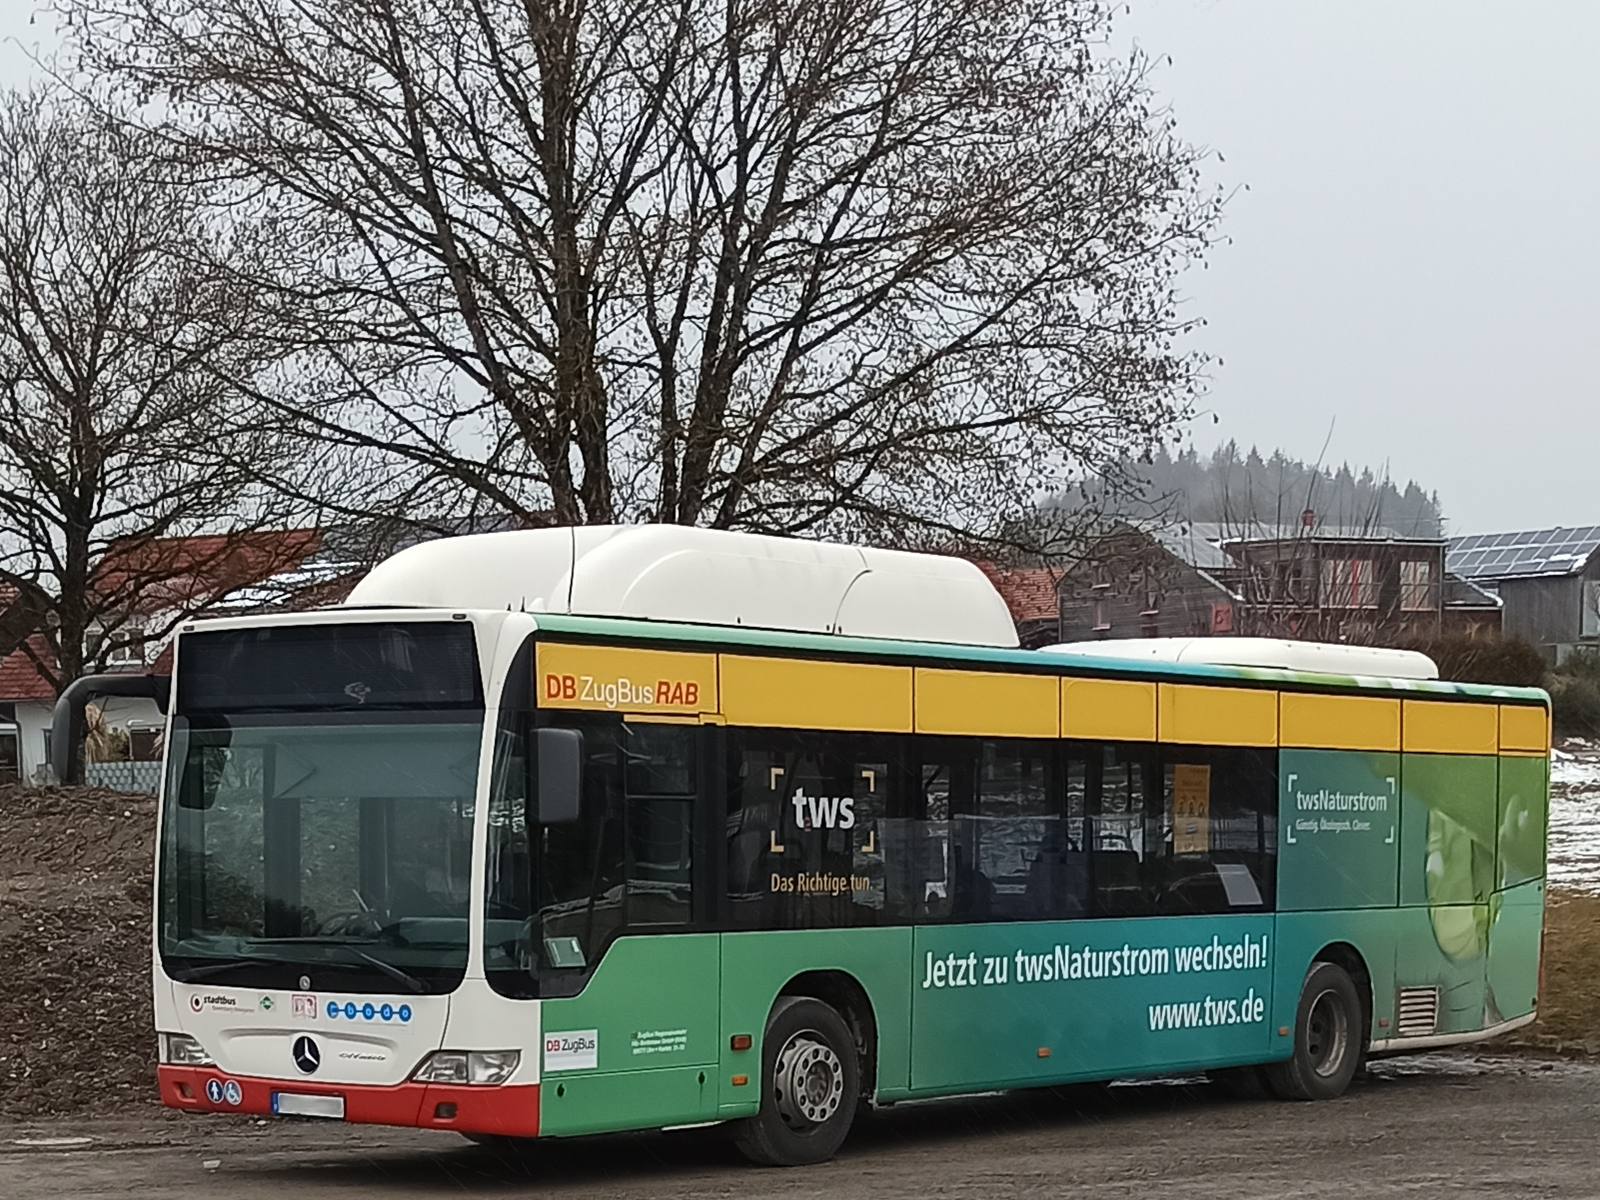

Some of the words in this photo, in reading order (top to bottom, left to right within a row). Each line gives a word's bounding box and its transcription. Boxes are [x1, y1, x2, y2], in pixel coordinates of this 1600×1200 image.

[546, 674, 576, 699] DB
[580, 676, 653, 708] ZugBus
[656, 681, 699, 705] RAB
[792, 787, 855, 829] tws
[1296, 789, 1387, 811] twsNaturstrom
[771, 873, 794, 892] Das
[797, 871, 847, 896] Richtige
[922, 952, 977, 989] Jetzt
[983, 958, 1008, 985] zu
[1015, 944, 1169, 982] twsNaturstrom
[1174, 934, 1268, 973] wechseln!
[203, 995, 236, 1006] stadtbus
[1149, 988, 1264, 1030] www.tws.de
[546, 1040, 560, 1052] DB
[561, 1037, 595, 1053] ZugBus
